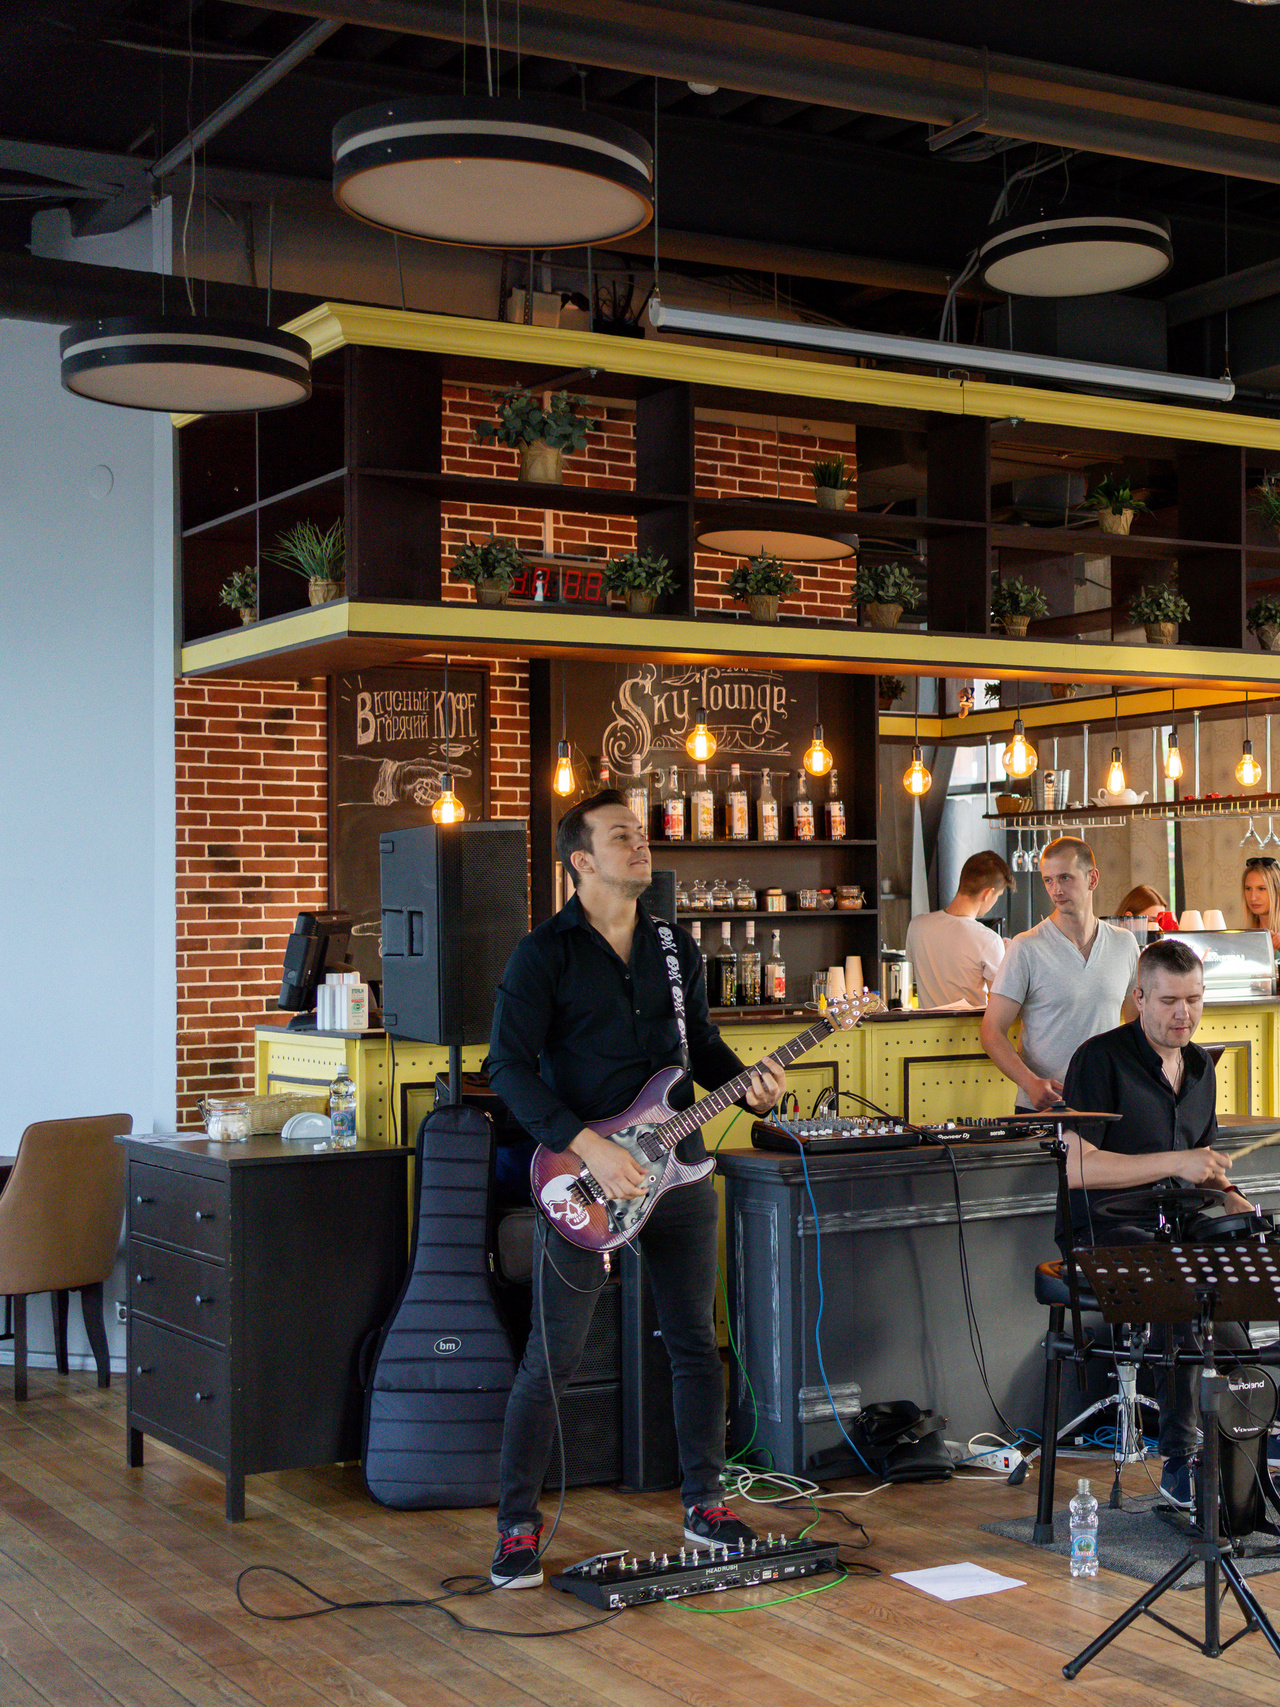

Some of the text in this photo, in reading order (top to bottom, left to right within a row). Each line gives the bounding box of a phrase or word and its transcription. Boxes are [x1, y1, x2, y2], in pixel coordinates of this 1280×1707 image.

[432, 690, 478, 739] КОФЕ
[440, 1341, 456, 1350] bm
[1238, 1380, 1265, 1390] Roland
